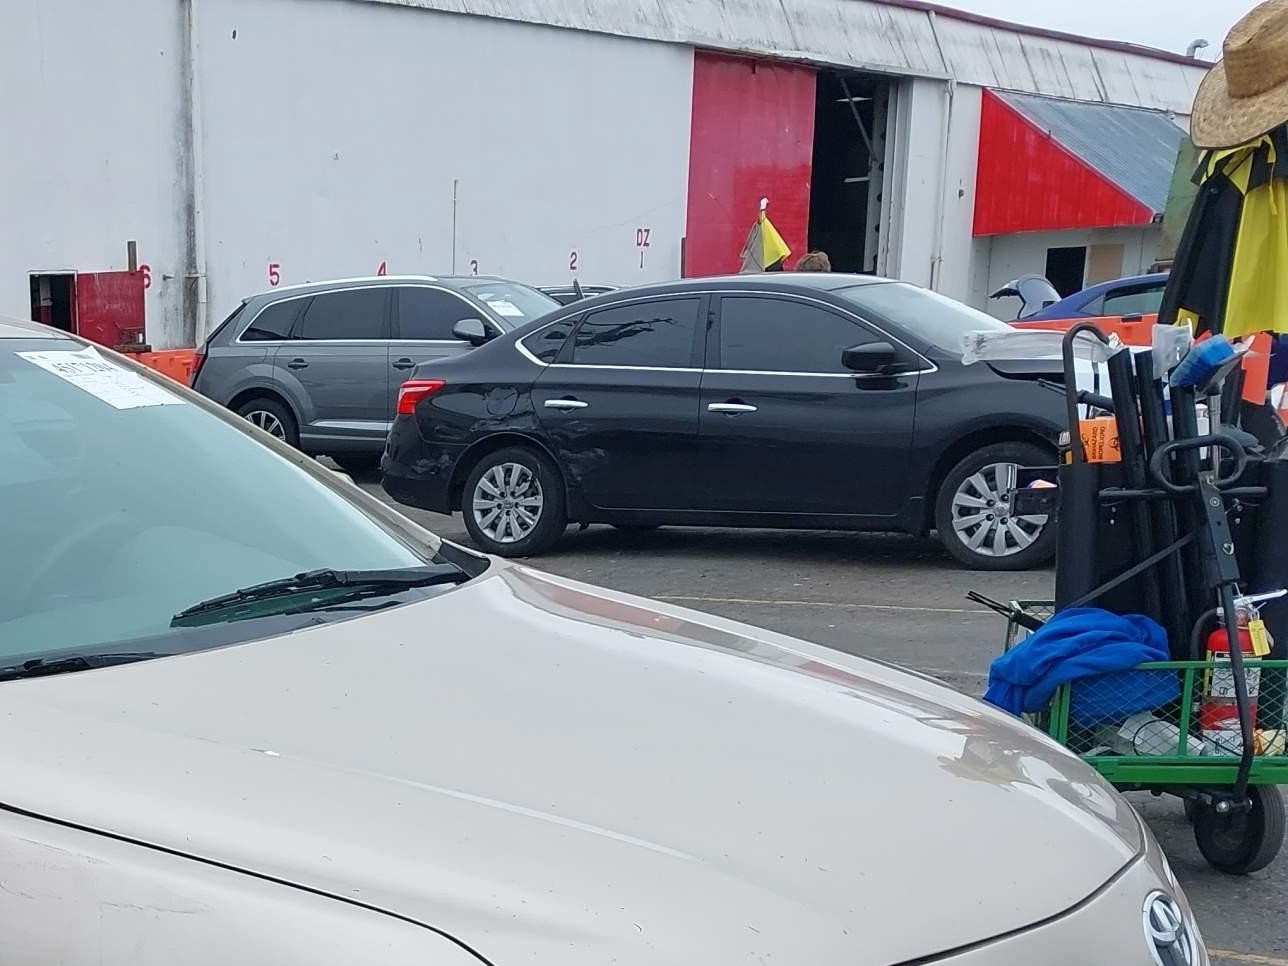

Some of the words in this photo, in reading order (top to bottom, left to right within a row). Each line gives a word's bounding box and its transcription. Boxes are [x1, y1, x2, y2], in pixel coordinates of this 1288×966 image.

[635, 228, 651, 247] DZ
[377, 261, 388, 277] 4
[470, 259, 479, 276] 3
[569, 251, 578, 271] 2
[269, 263, 280, 287] 5
